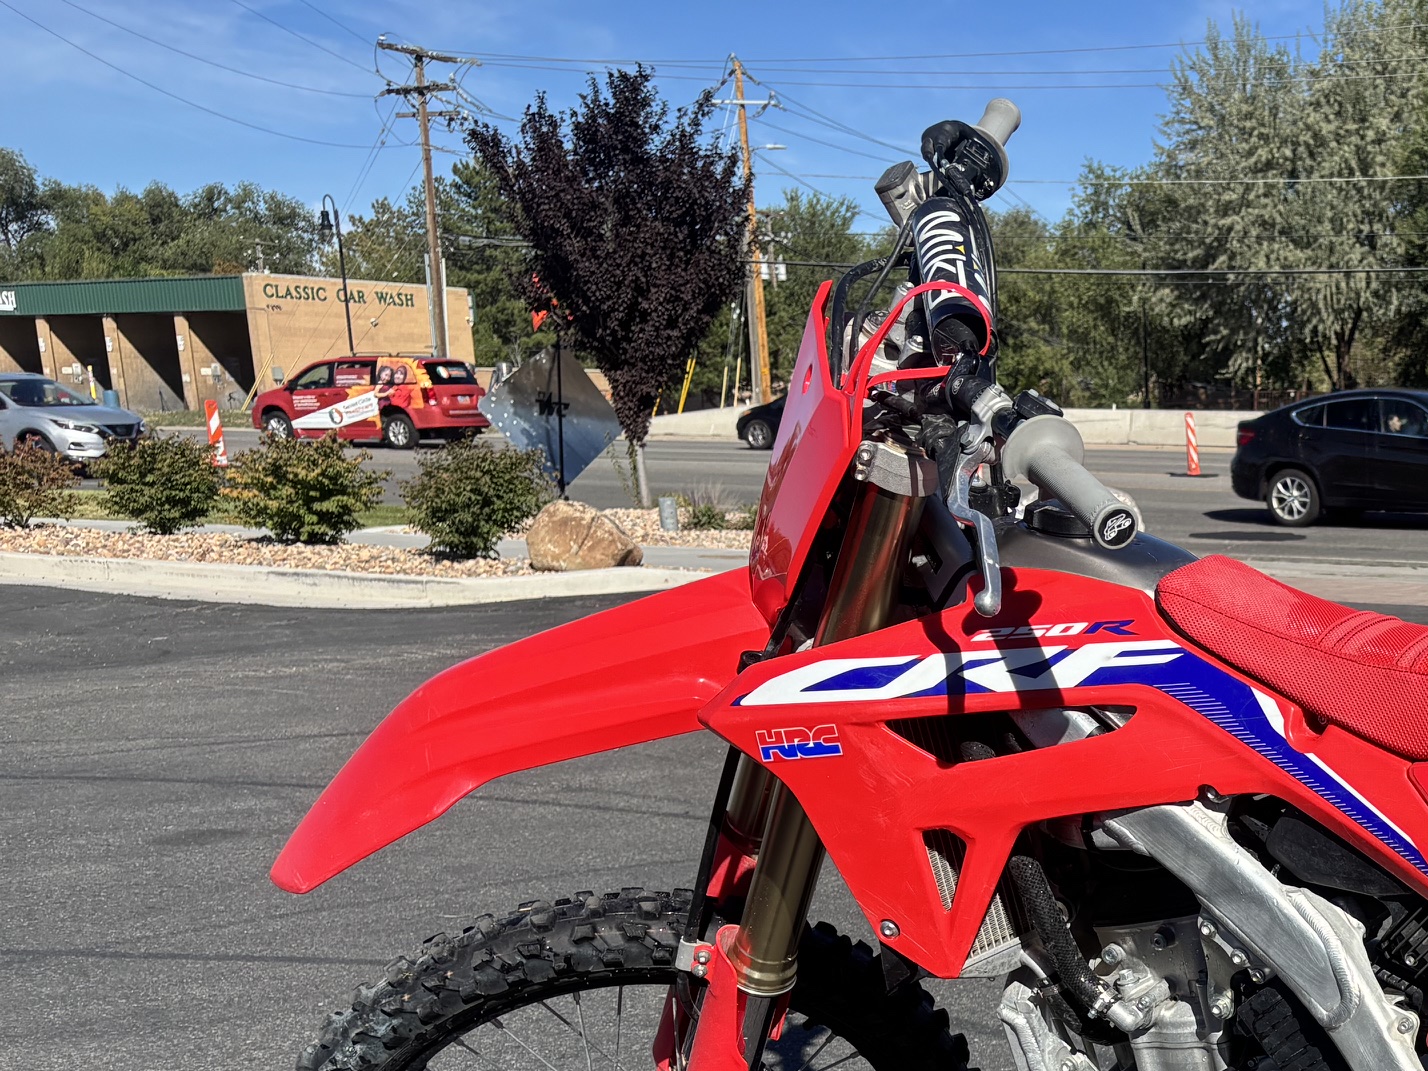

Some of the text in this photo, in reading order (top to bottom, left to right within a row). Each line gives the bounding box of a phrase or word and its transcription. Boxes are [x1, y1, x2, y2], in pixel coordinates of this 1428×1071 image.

[262, 283, 415, 308] CLASSIC CAR WASH
[970, 619, 1140, 642] 250R
[741, 639, 1185, 706] CRF
[756, 723, 845, 763] HRC
